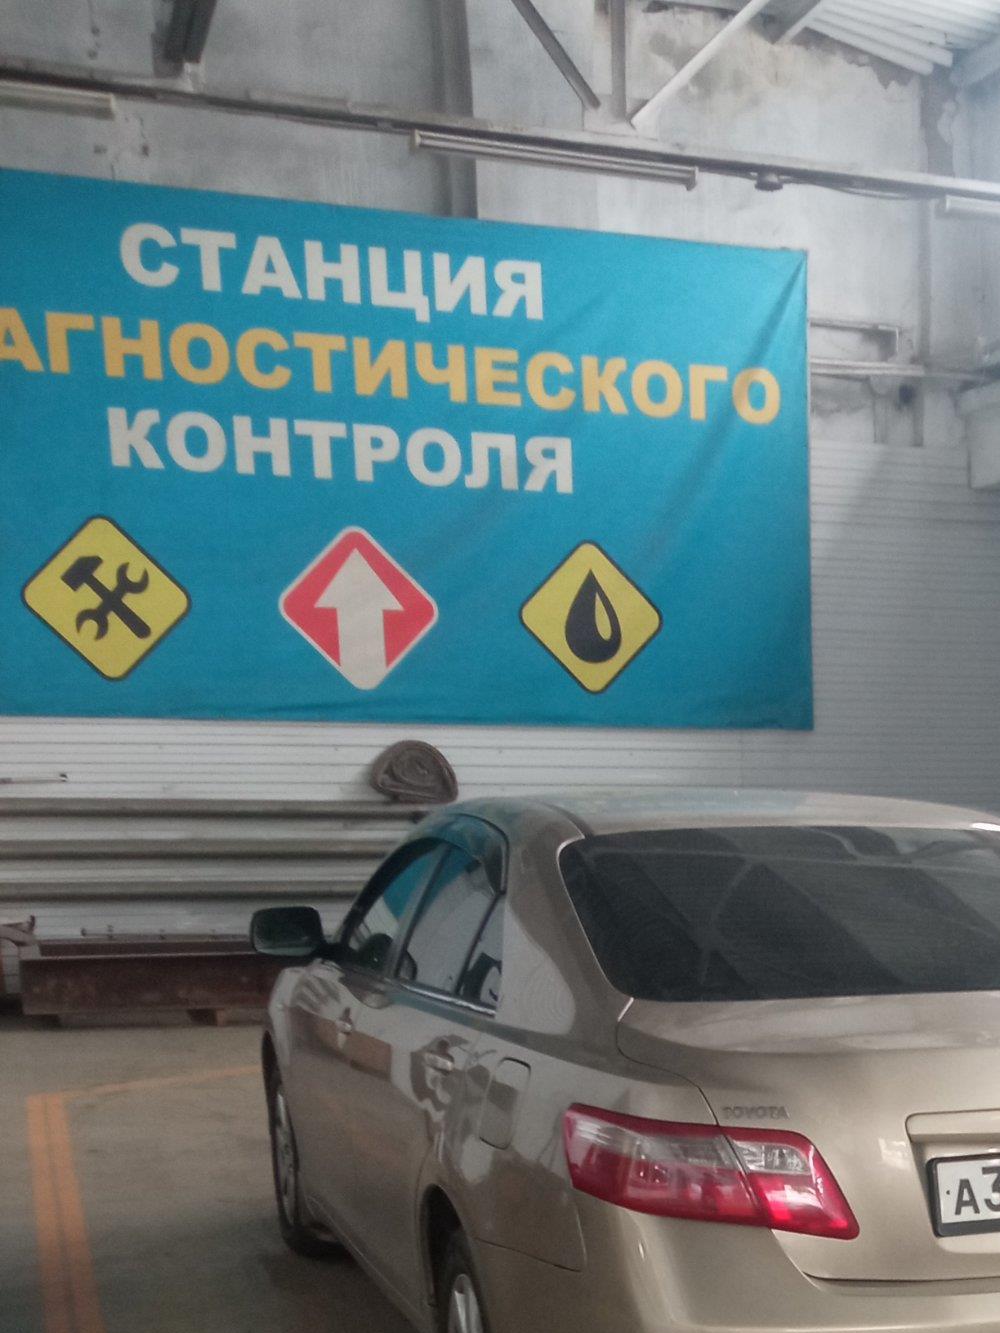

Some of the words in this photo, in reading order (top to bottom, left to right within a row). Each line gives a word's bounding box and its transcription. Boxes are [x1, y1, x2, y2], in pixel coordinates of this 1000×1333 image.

[120, 223, 544, 322] СТАНЦИЯ
[107, 407, 575, 494] КОНТРОЛЯ
[722, 1105, 791, 1120] TOYOTA
